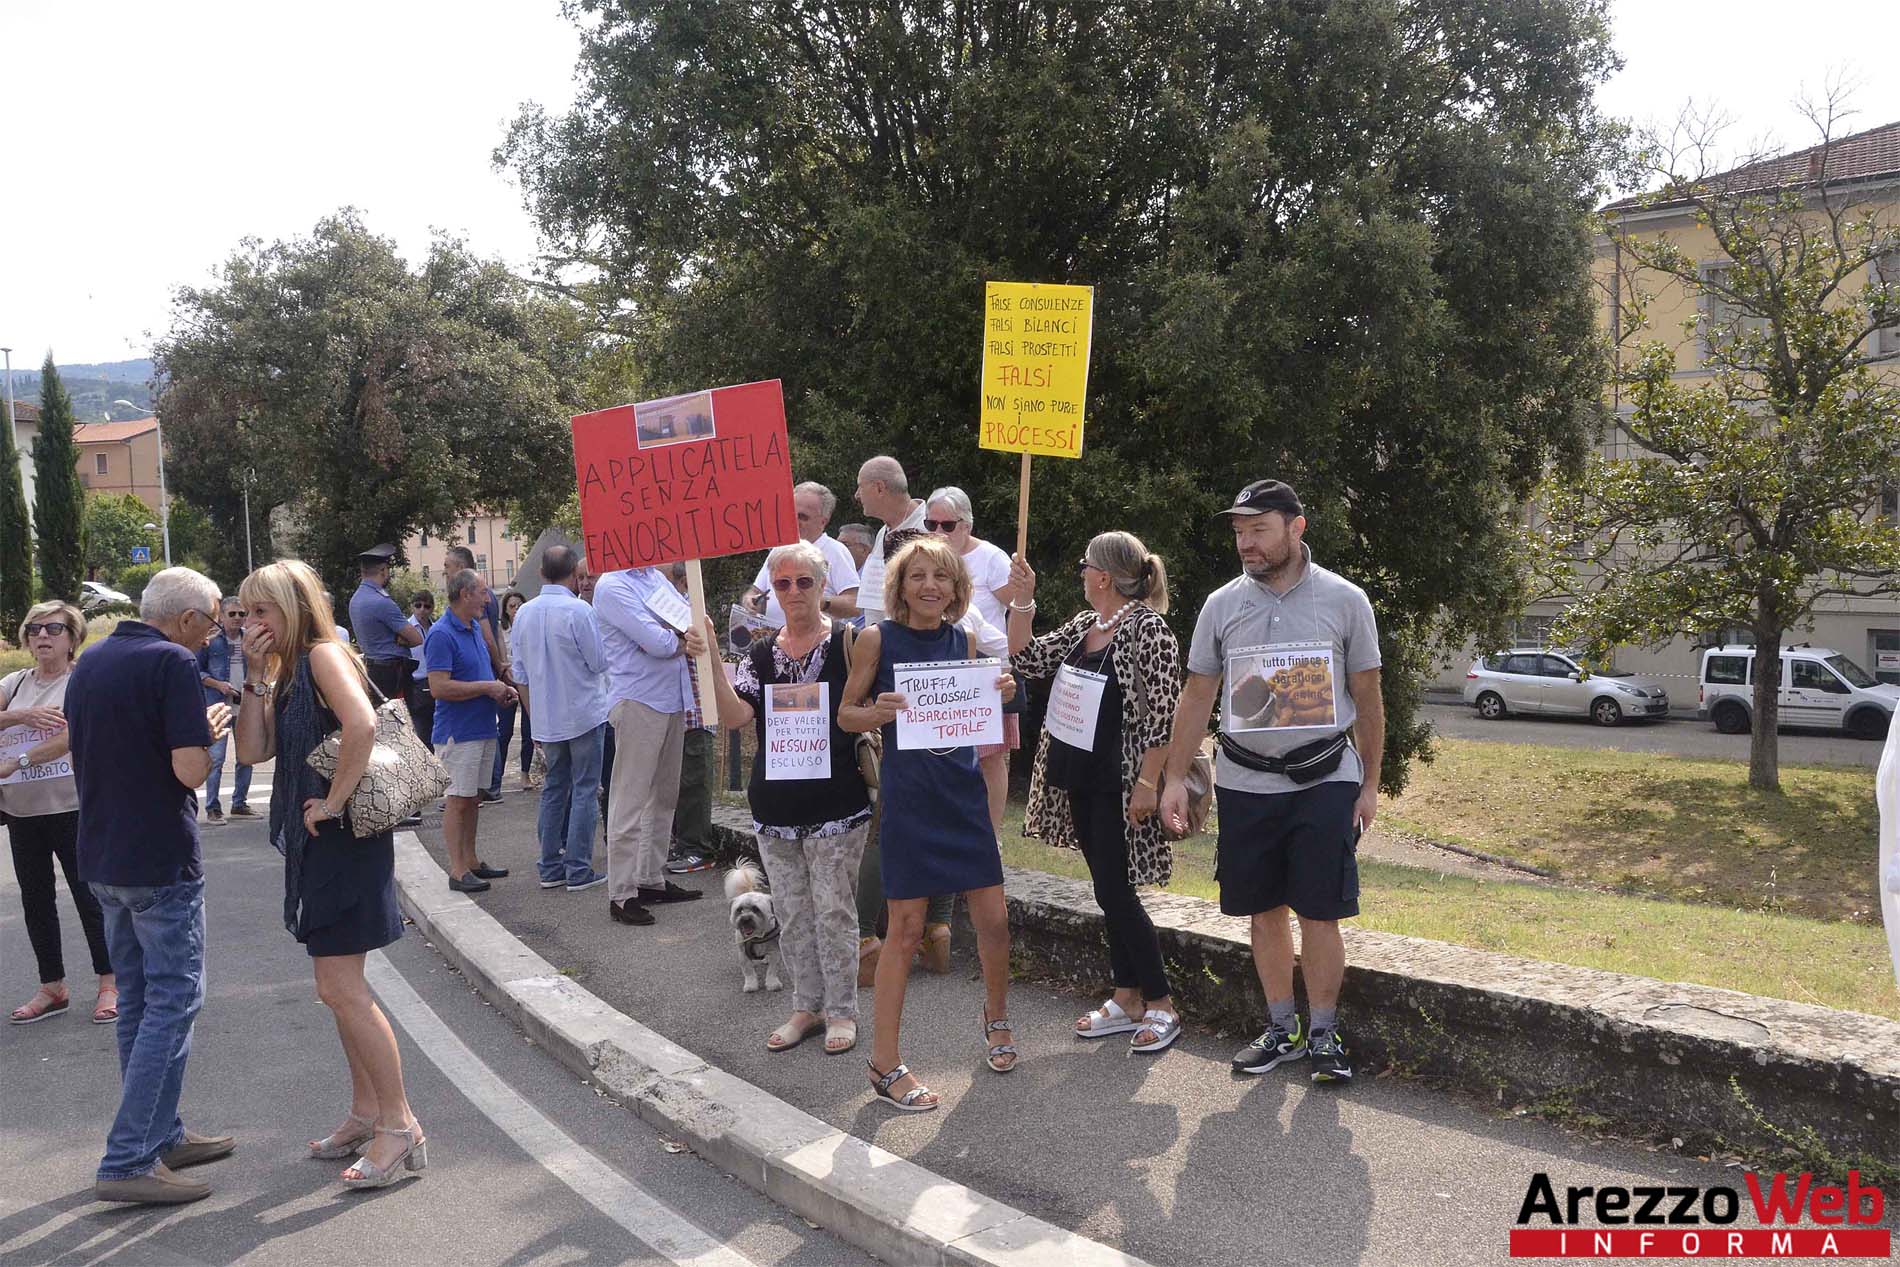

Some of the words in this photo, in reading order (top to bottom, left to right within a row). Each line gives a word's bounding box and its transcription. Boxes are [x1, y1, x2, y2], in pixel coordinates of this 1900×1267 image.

[1020, 297, 1085, 311] CONSULENZE
[1024, 316, 1078, 334] BiLANCi
[1022, 341, 1078, 357] PROSPETTi
[996, 364, 1053, 388] FALSi
[986, 394, 1006, 410] NON
[1013, 397, 1045, 413] SiANO
[1050, 400, 1079, 414] PURE
[985, 422, 1077, 450] PROCESSi
[583, 431, 783, 498] APPLICATELA
[621, 476, 721, 516] SENZA
[587, 493, 783, 571] FAVORITISMI
[1262, 656, 1286, 668] tutto
[1324, 656, 1330, 664] a
[900, 676, 957, 692] TRUFFA
[917, 687, 981, 706] COLOSSALE
[767, 716, 790, 727] DEVE
[795, 716, 827, 725] VALERE
[901, 706, 992, 723] RiSARCiMENTO
[776, 728, 791, 736] PER
[796, 727, 820, 735] TUTTI
[932, 720, 987, 739] TOTALE
[771, 738, 828, 752] NESSUNO
[20, 761, 70, 780] RUBATO
[771, 756, 822, 768] ESCLUSO
